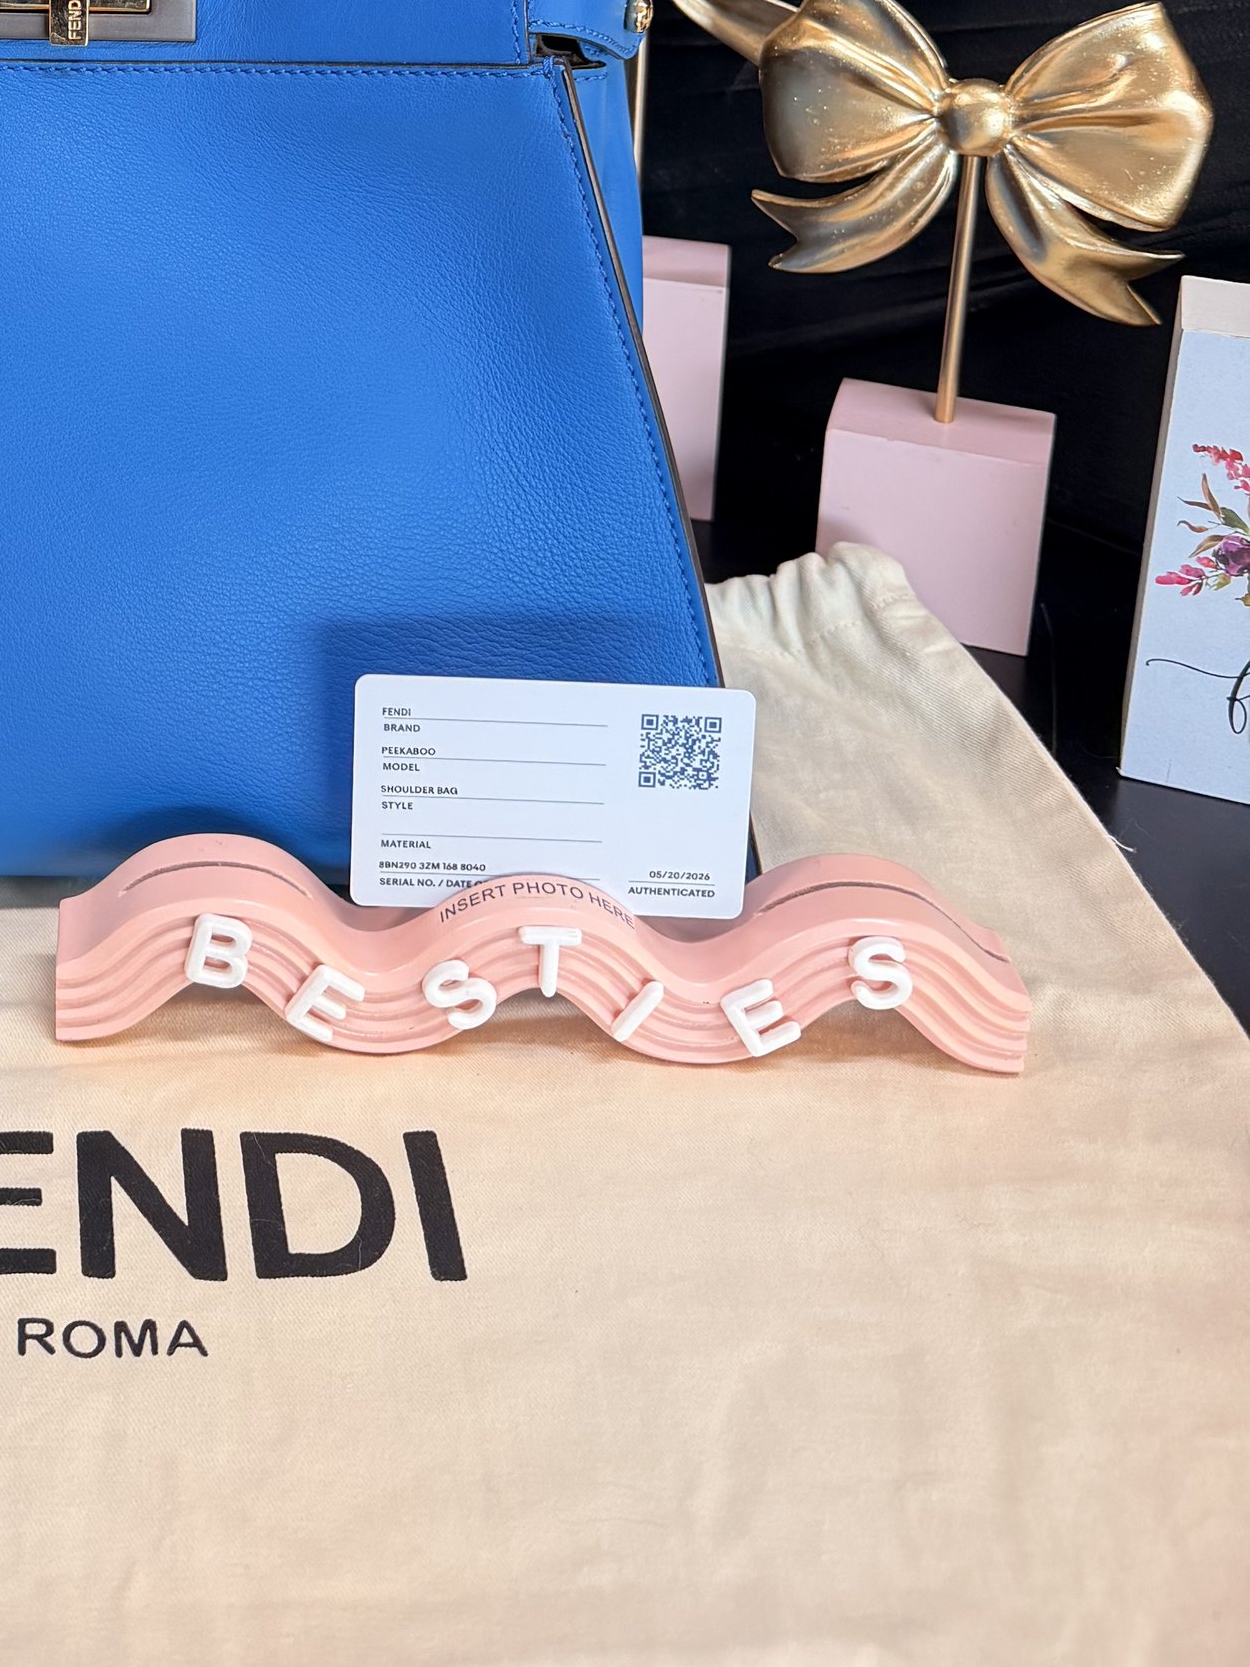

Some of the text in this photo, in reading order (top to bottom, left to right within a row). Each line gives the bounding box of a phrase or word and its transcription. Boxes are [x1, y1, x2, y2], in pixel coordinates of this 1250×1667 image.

[382, 707, 411, 717] FENDI
[383, 723, 421, 733] BRAND
[381, 746, 436, 756] PEEKABOO
[382, 762, 420, 772] MODEL
[380, 785, 458, 795] SHOULDER BAG
[381, 801, 413, 810] STYLE
[380, 839, 431, 849] MATERIAL
[378, 861, 486, 872] 8BN290 3ZM 168 8040
[649, 870, 711, 881] 05/20/2026
[379, 877, 415, 887] SERIAL
[417, 879, 436, 887] NO.
[446, 879, 472, 888] DATE
[628, 886, 715, 898] AUTHENTICATED
[440, 882, 636, 930] INSERT PHOTO HERE
[184, 913, 914, 1058] BESTIES
[16, 1317, 209, 1359] ROMA
